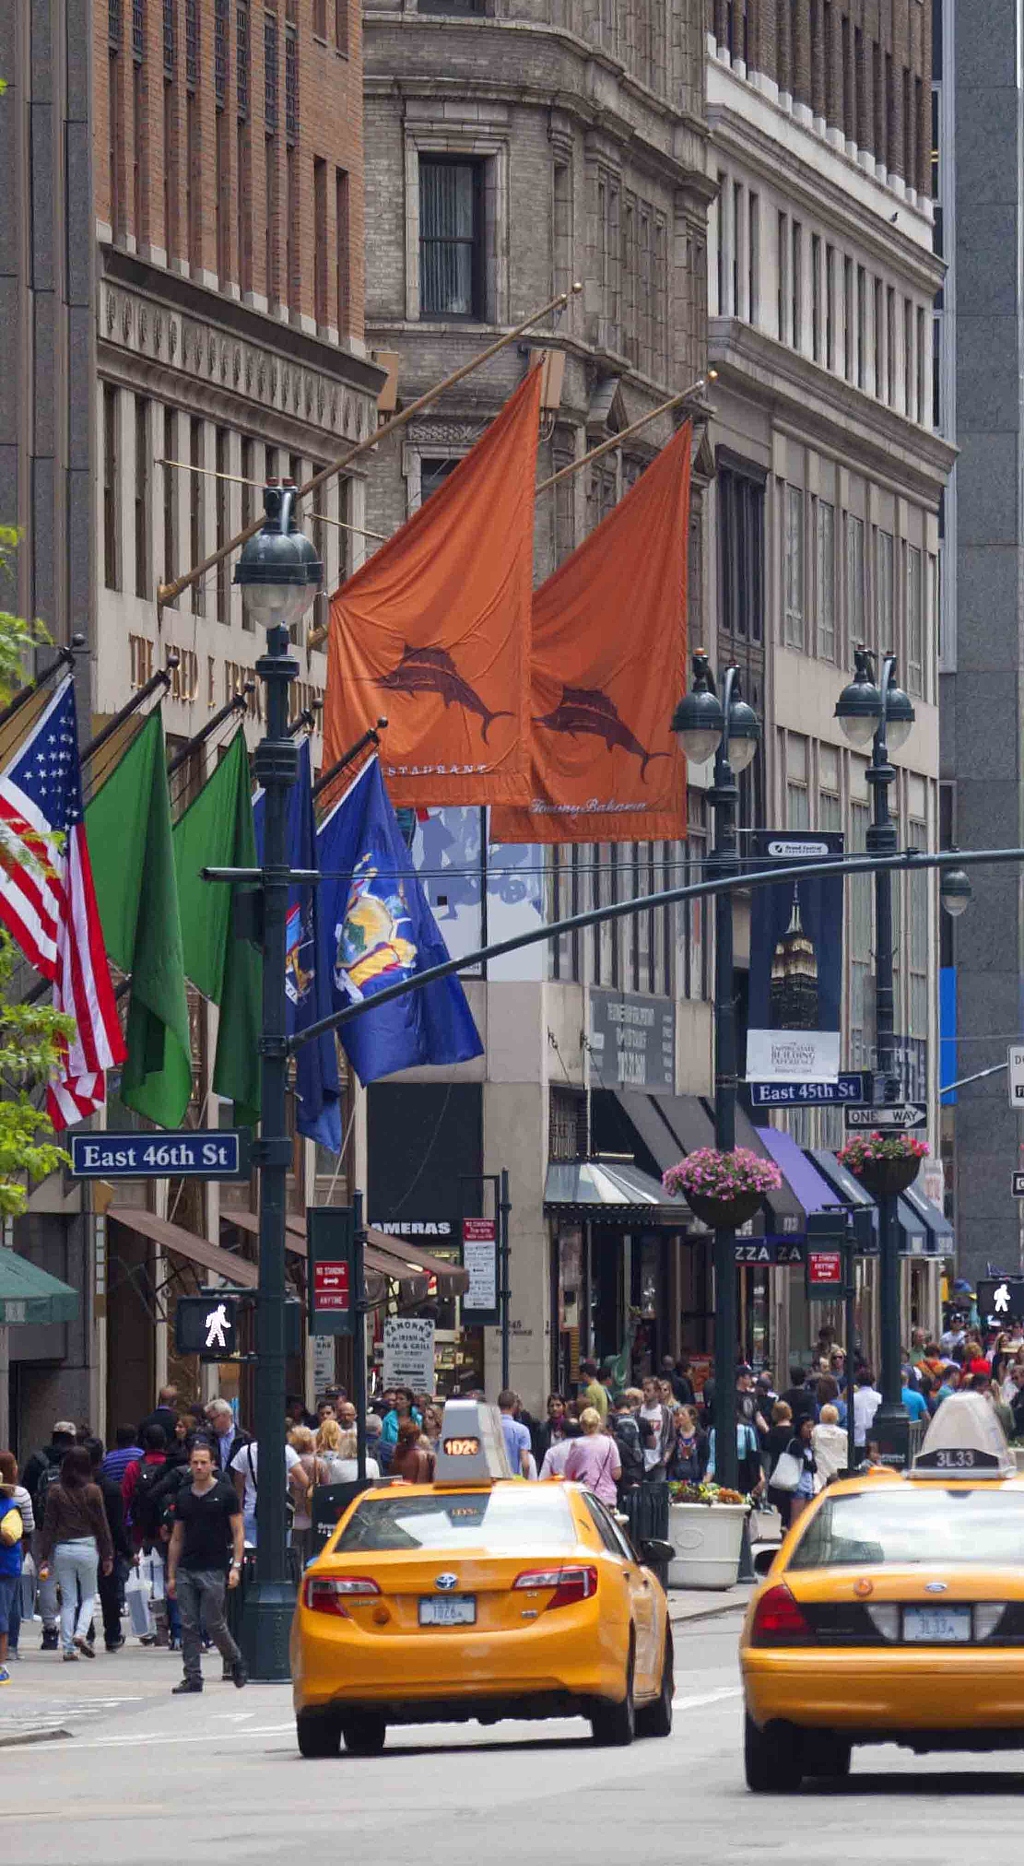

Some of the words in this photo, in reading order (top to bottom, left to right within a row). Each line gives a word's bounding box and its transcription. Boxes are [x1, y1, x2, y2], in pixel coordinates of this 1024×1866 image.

[382, 763, 487, 777] STAURANT
[759, 1085, 796, 1100] East
[799, 1083, 833, 1099] 45th
[837, 1082, 856, 1097] St
[851, 1110, 878, 1122] ONE
[893, 1110, 919, 1121] WAY
[83, 1146, 136, 1167] East
[143, 1144, 195, 1166] 46th
[202, 1143, 228, 1166] St
[371, 1222, 452, 1235] AMERAS
[936, 1450, 974, 1467] 3L33
